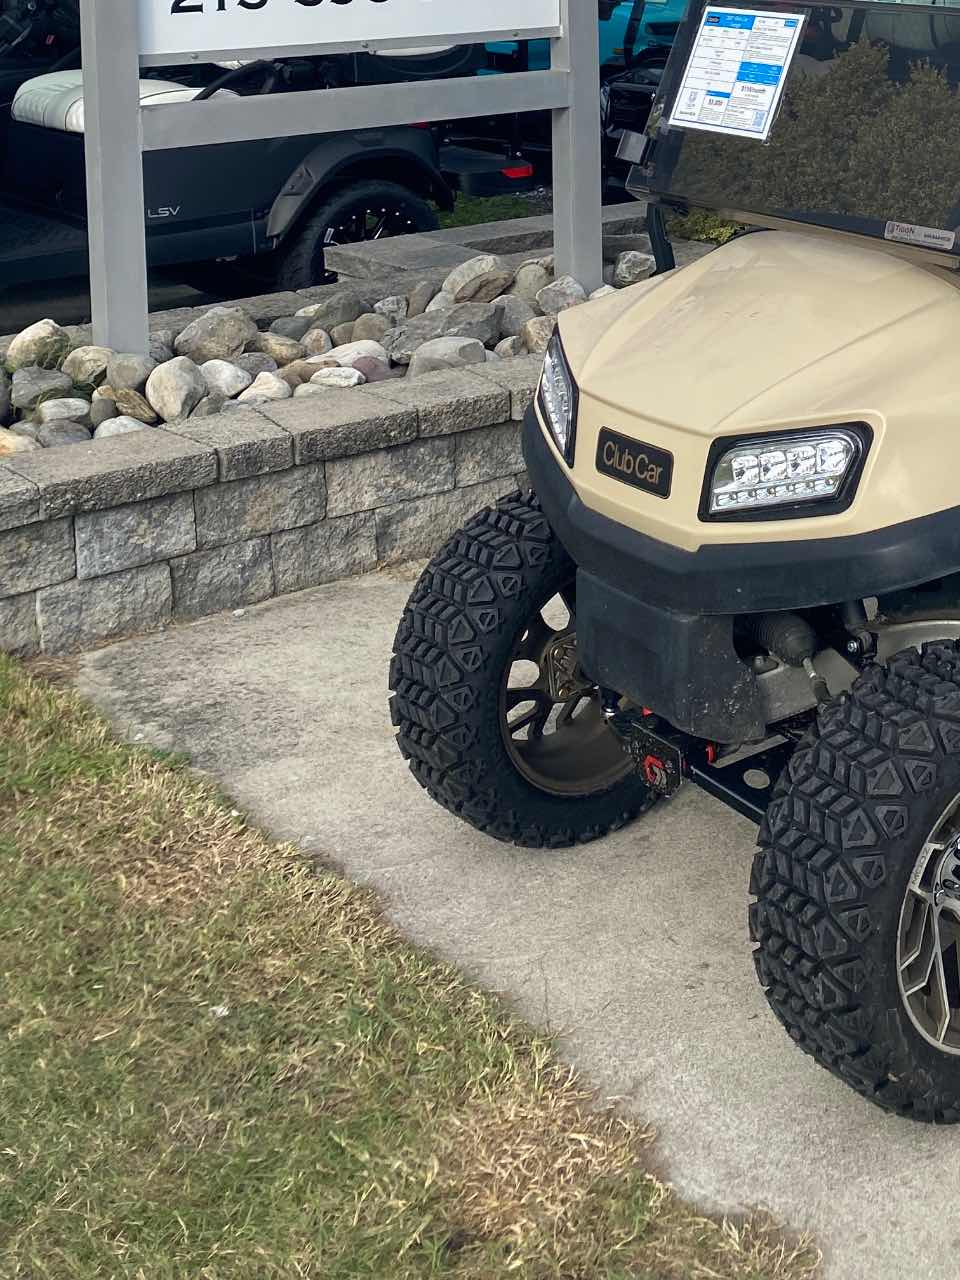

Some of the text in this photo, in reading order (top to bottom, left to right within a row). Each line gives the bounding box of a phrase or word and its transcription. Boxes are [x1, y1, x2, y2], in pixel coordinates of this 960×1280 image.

[147, 206, 180, 218] LSV
[602, 440, 664, 485] Club Car
